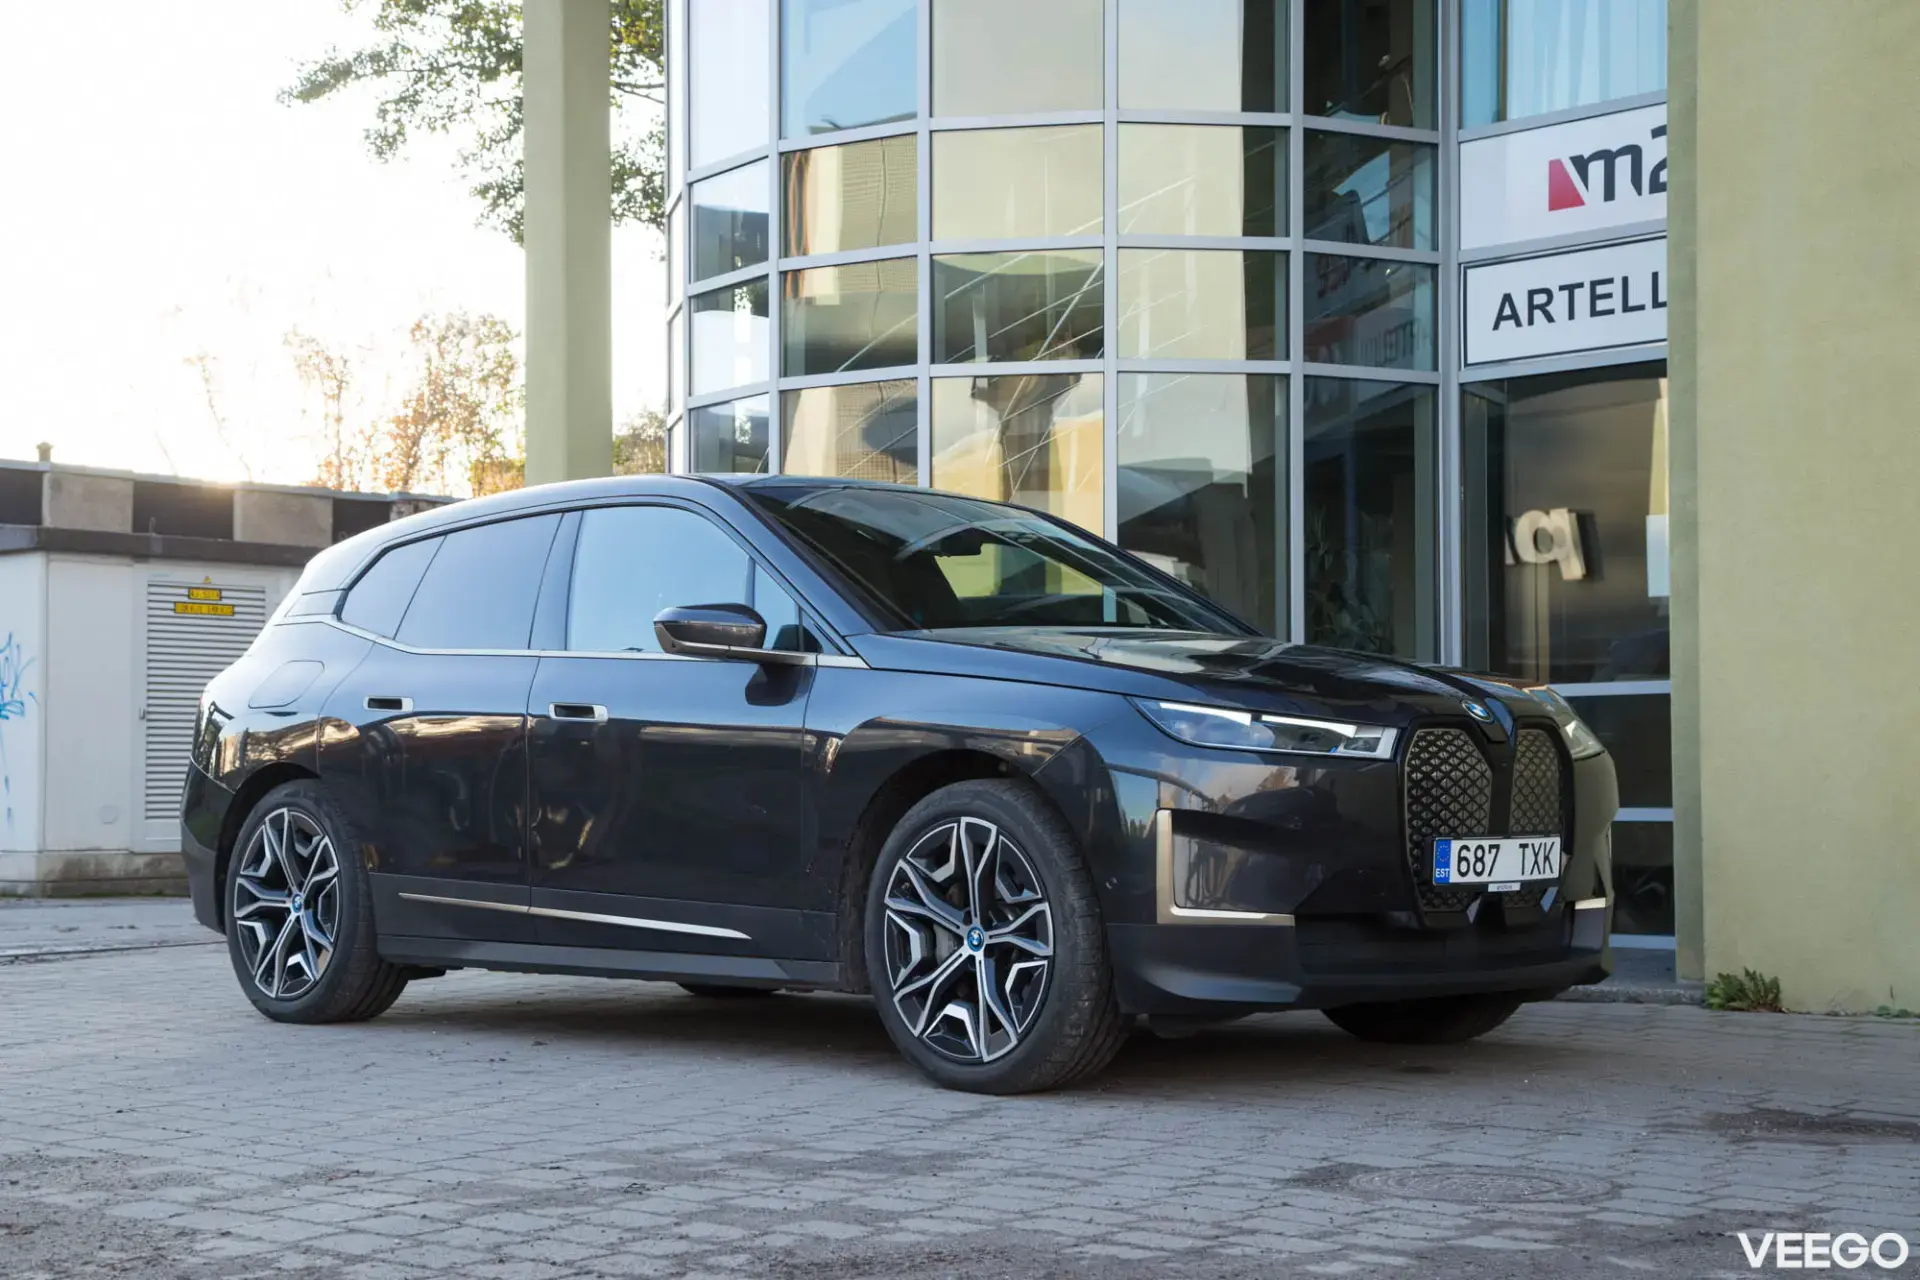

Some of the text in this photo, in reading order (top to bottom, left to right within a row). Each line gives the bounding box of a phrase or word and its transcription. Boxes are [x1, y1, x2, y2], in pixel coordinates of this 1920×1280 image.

[1457, 841, 1555, 877] 687 TXK
[1435, 868, 1450, 878] EST
